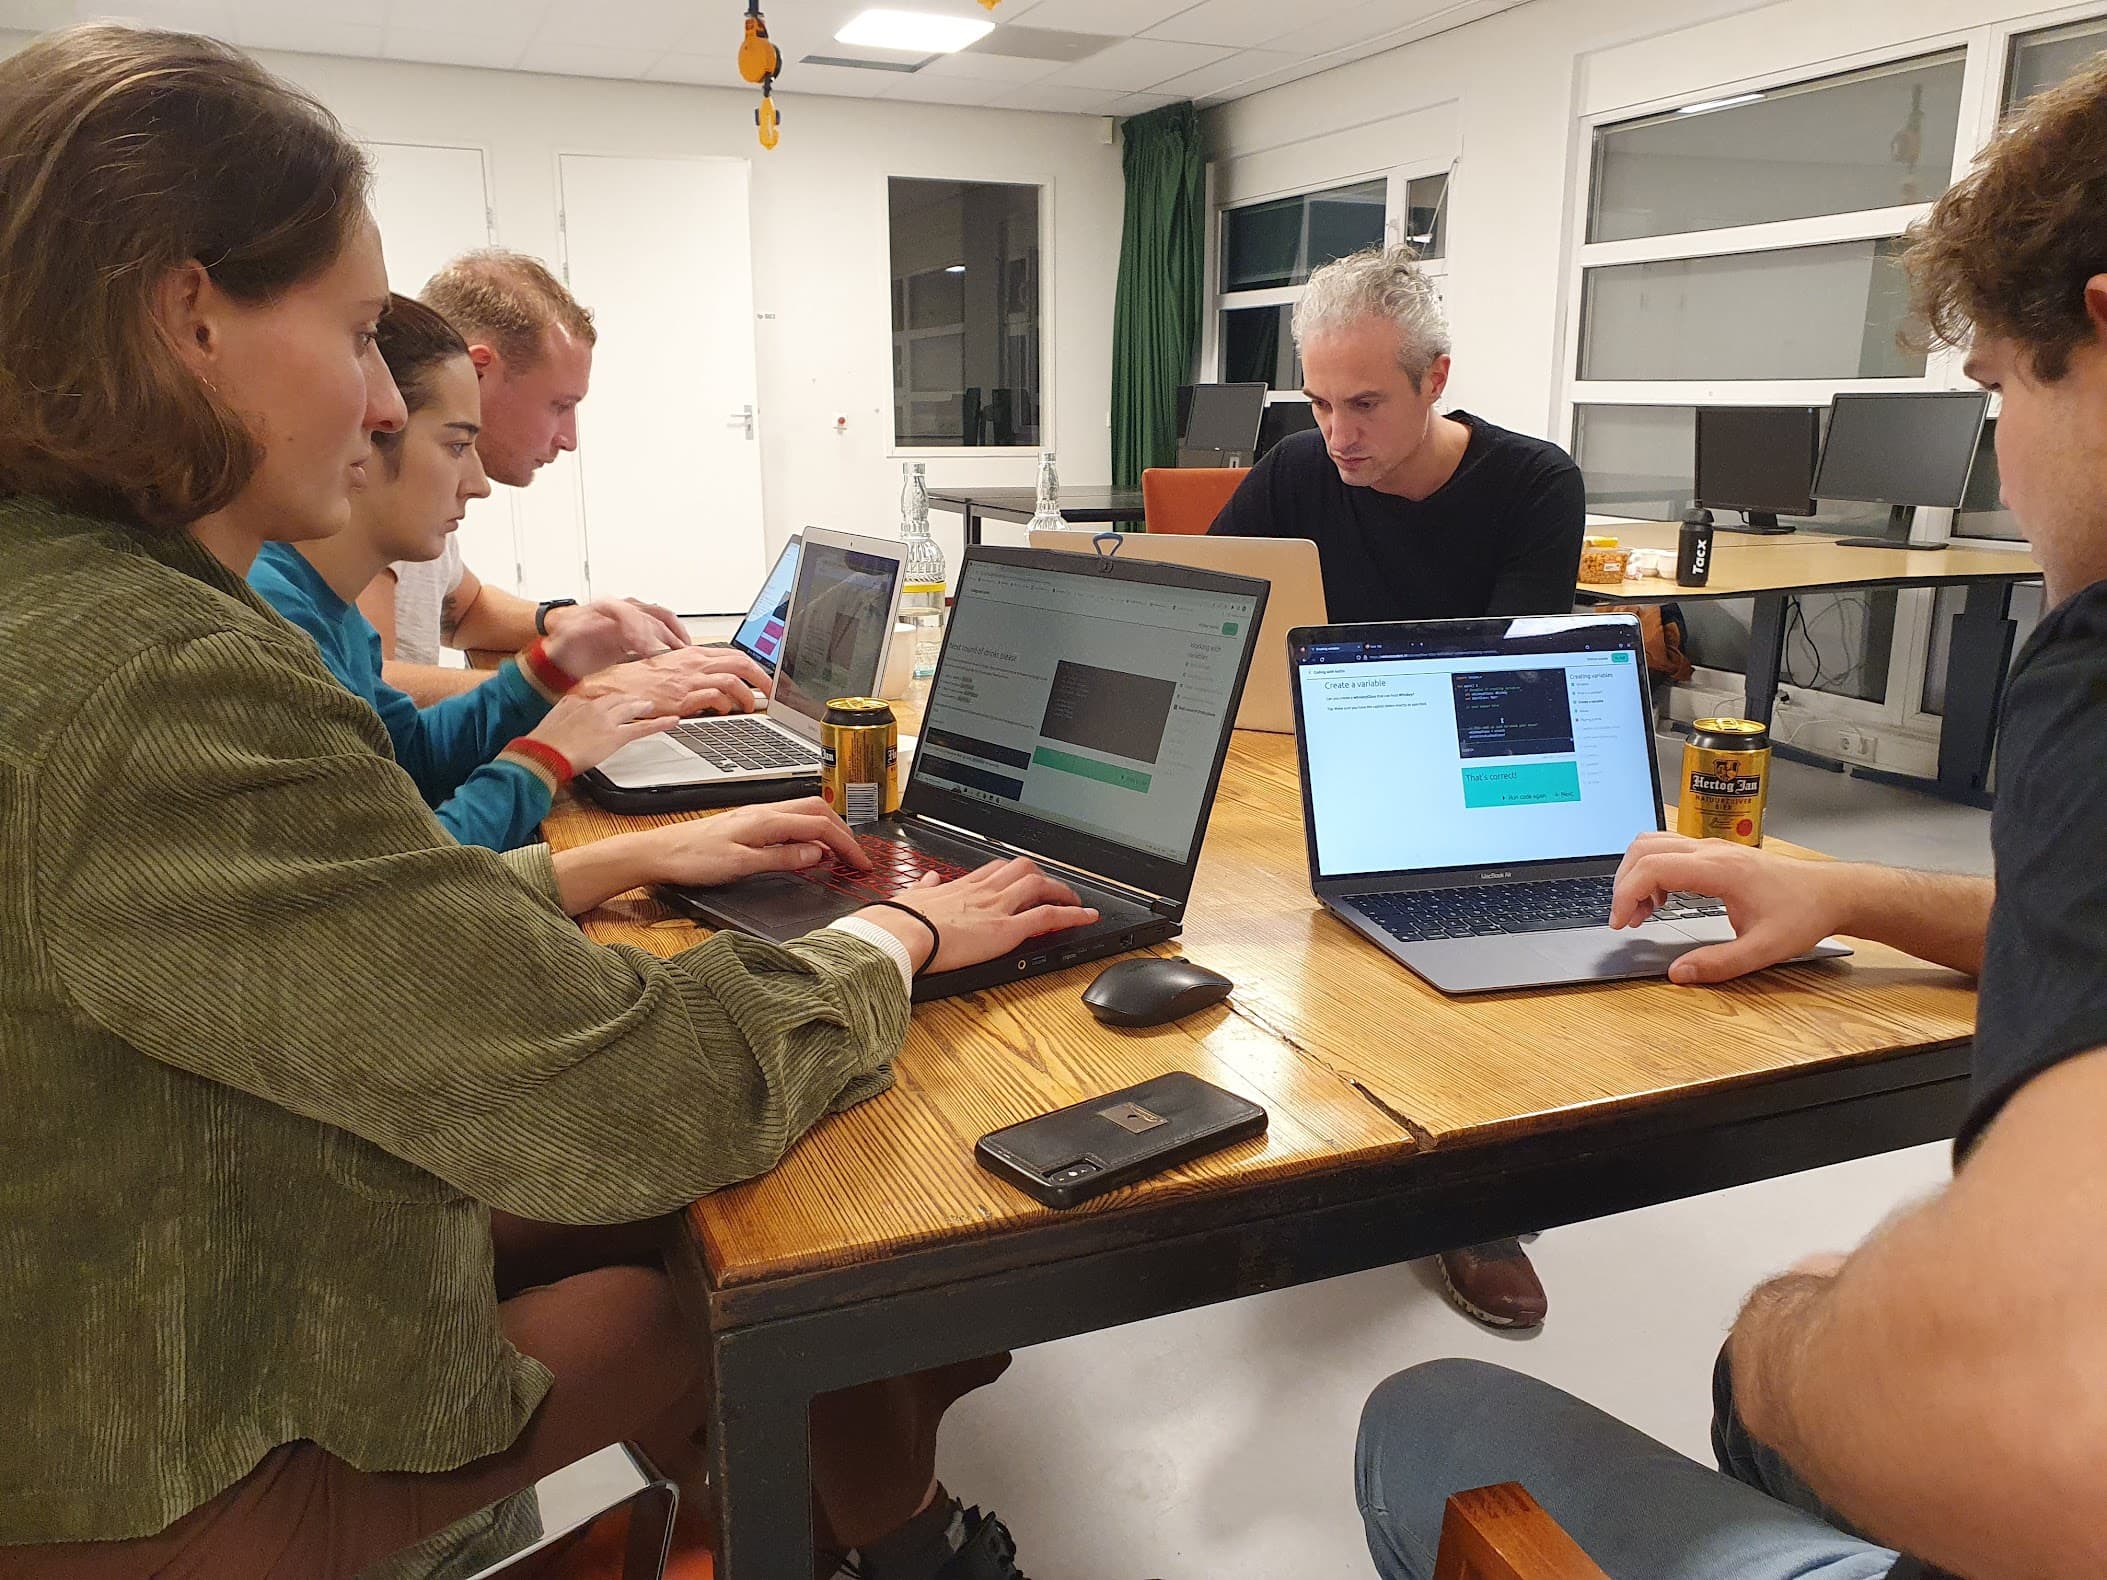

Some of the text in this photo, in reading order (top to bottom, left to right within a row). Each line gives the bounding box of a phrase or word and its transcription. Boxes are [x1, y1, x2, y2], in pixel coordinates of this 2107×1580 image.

[1692, 539, 1707, 574] Tacx
[1324, 681, 1350, 690] Create
[1357, 679, 1387, 688] variable
[1465, 771, 1517, 782] That's correct!
[1692, 775, 1758, 794] Hertog Jan
